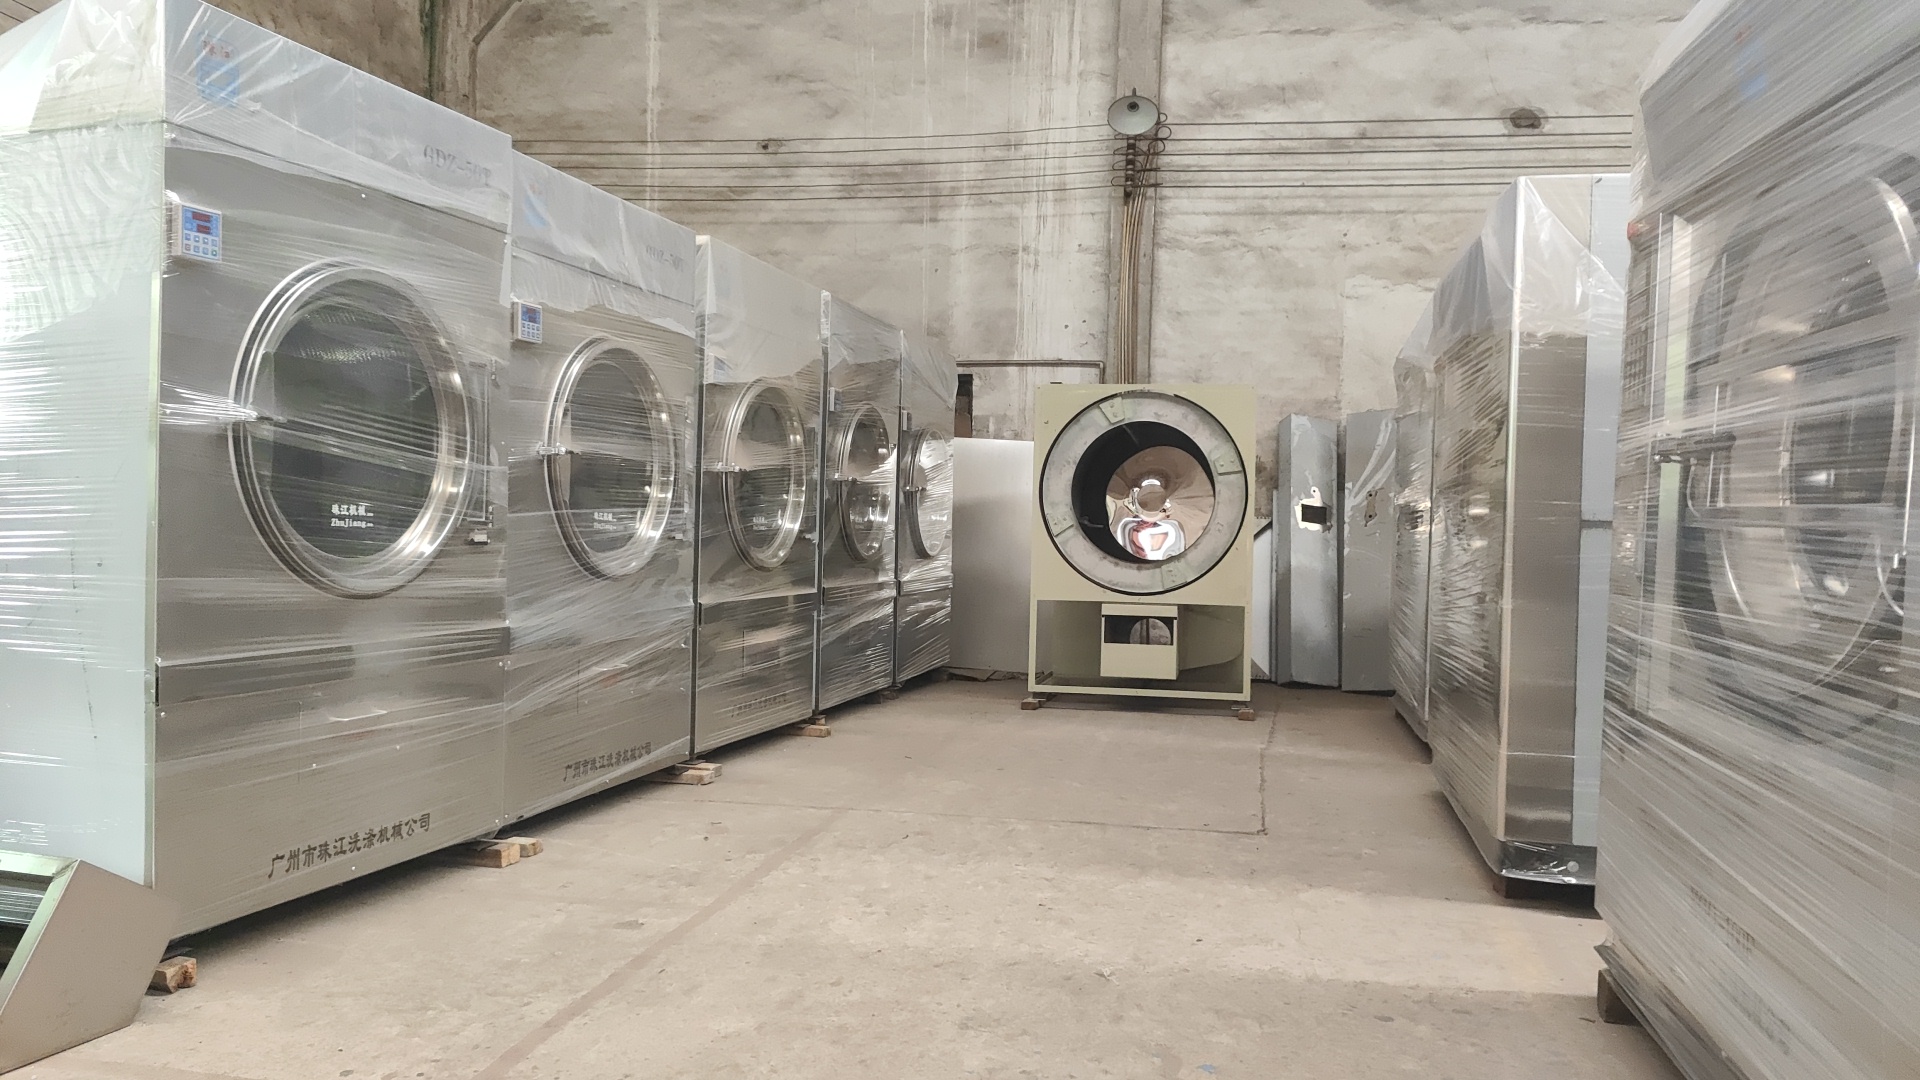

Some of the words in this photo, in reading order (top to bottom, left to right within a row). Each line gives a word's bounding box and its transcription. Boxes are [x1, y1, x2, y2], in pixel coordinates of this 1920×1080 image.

[268, 813, 431, 879] 广州市珠江洗涤机械公司
